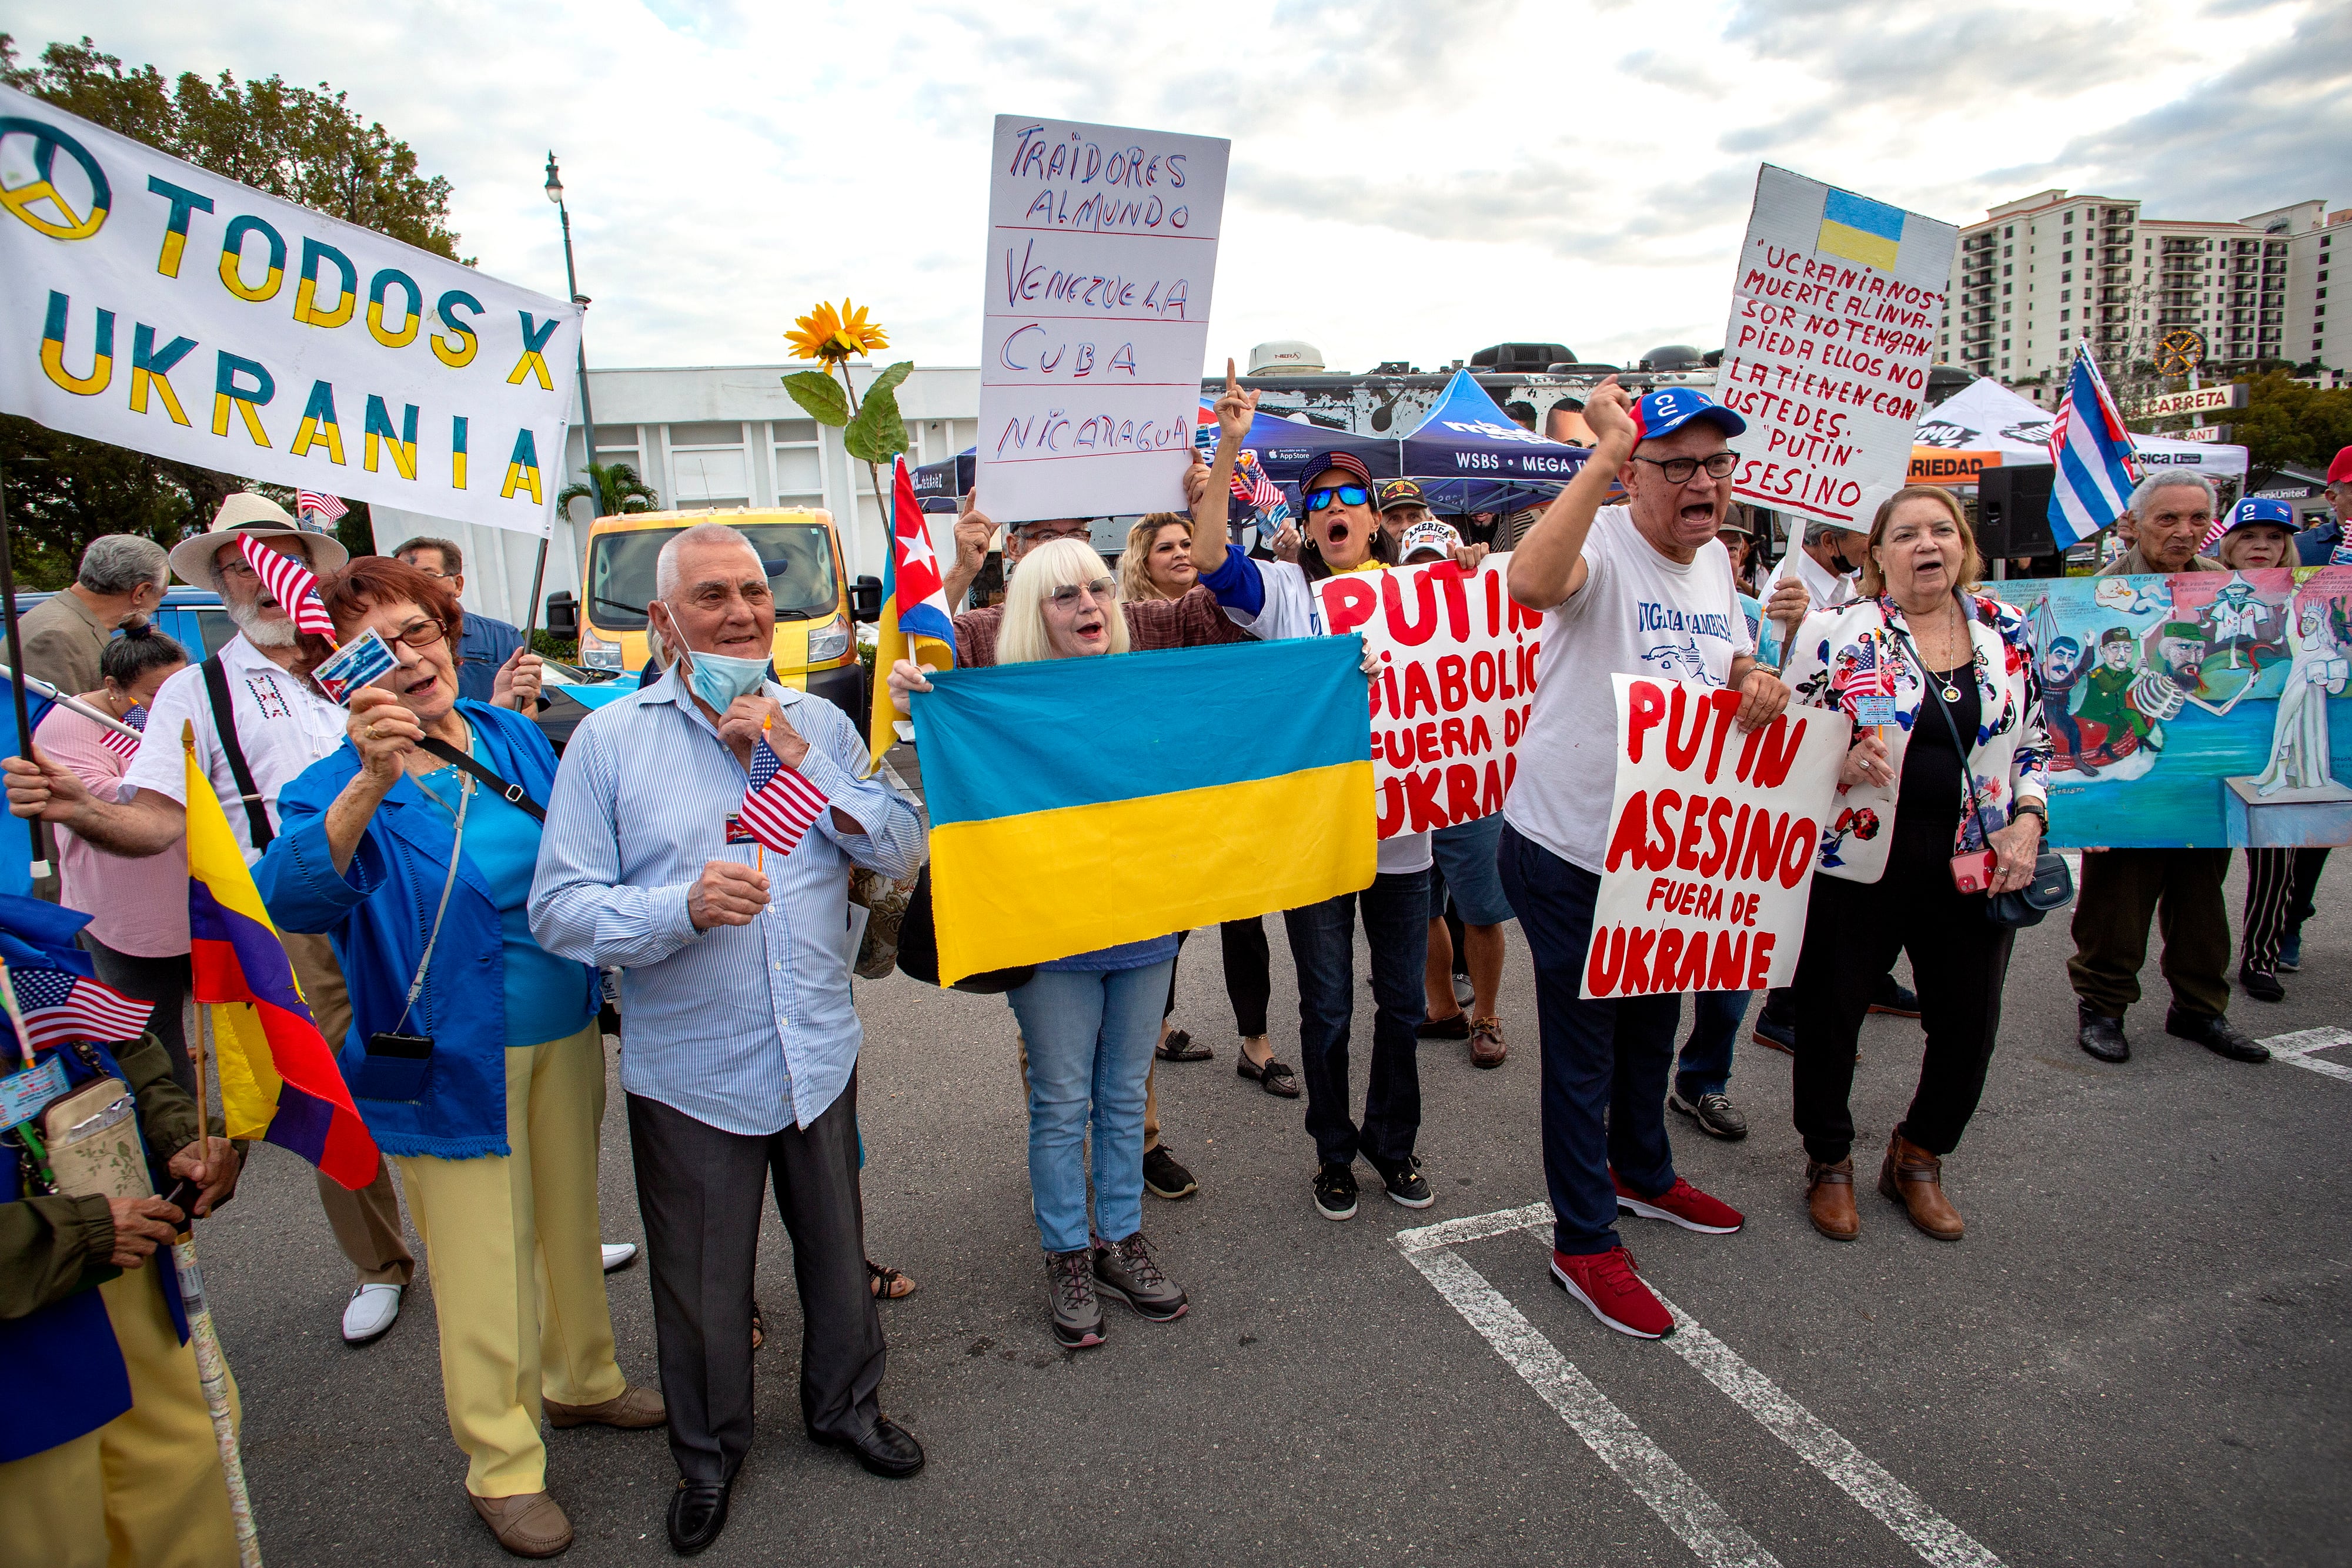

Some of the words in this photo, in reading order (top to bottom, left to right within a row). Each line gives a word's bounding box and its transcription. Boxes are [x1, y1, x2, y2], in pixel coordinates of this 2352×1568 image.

[148, 175, 486, 368] TODOS
[507, 310, 561, 390] X
[1006, 238, 1188, 320] VENEZUELA
[1743, 269, 1836, 313] MUERTE
[1742, 299, 1796, 329] SOR
[1804, 313, 1839, 340] NO
[1000, 324, 1135, 377] CUBA
[1822, 343, 1883, 377] ELLOS
[1888, 362, 1923, 390] NO
[41, 289, 543, 506] UKRANIA
[1873, 392, 1918, 421] CON
[2147, 391, 2226, 413] CARRETA
[1455, 452, 1499, 470] WSBS
[1522, 456, 1571, 473] MEGA
[1735, 459, 1861, 508] SESINO
[2254, 489, 2307, 499] BankUnited
[1409, 523, 1449, 539] AMERICA
[1627, 680, 1808, 788] PUTIN
[1605, 788, 1818, 890] ASESINO
[1646, 877, 1725, 921] FUERA
[1730, 892, 1761, 927] DE
[1587, 921, 1776, 998] UKRANE
